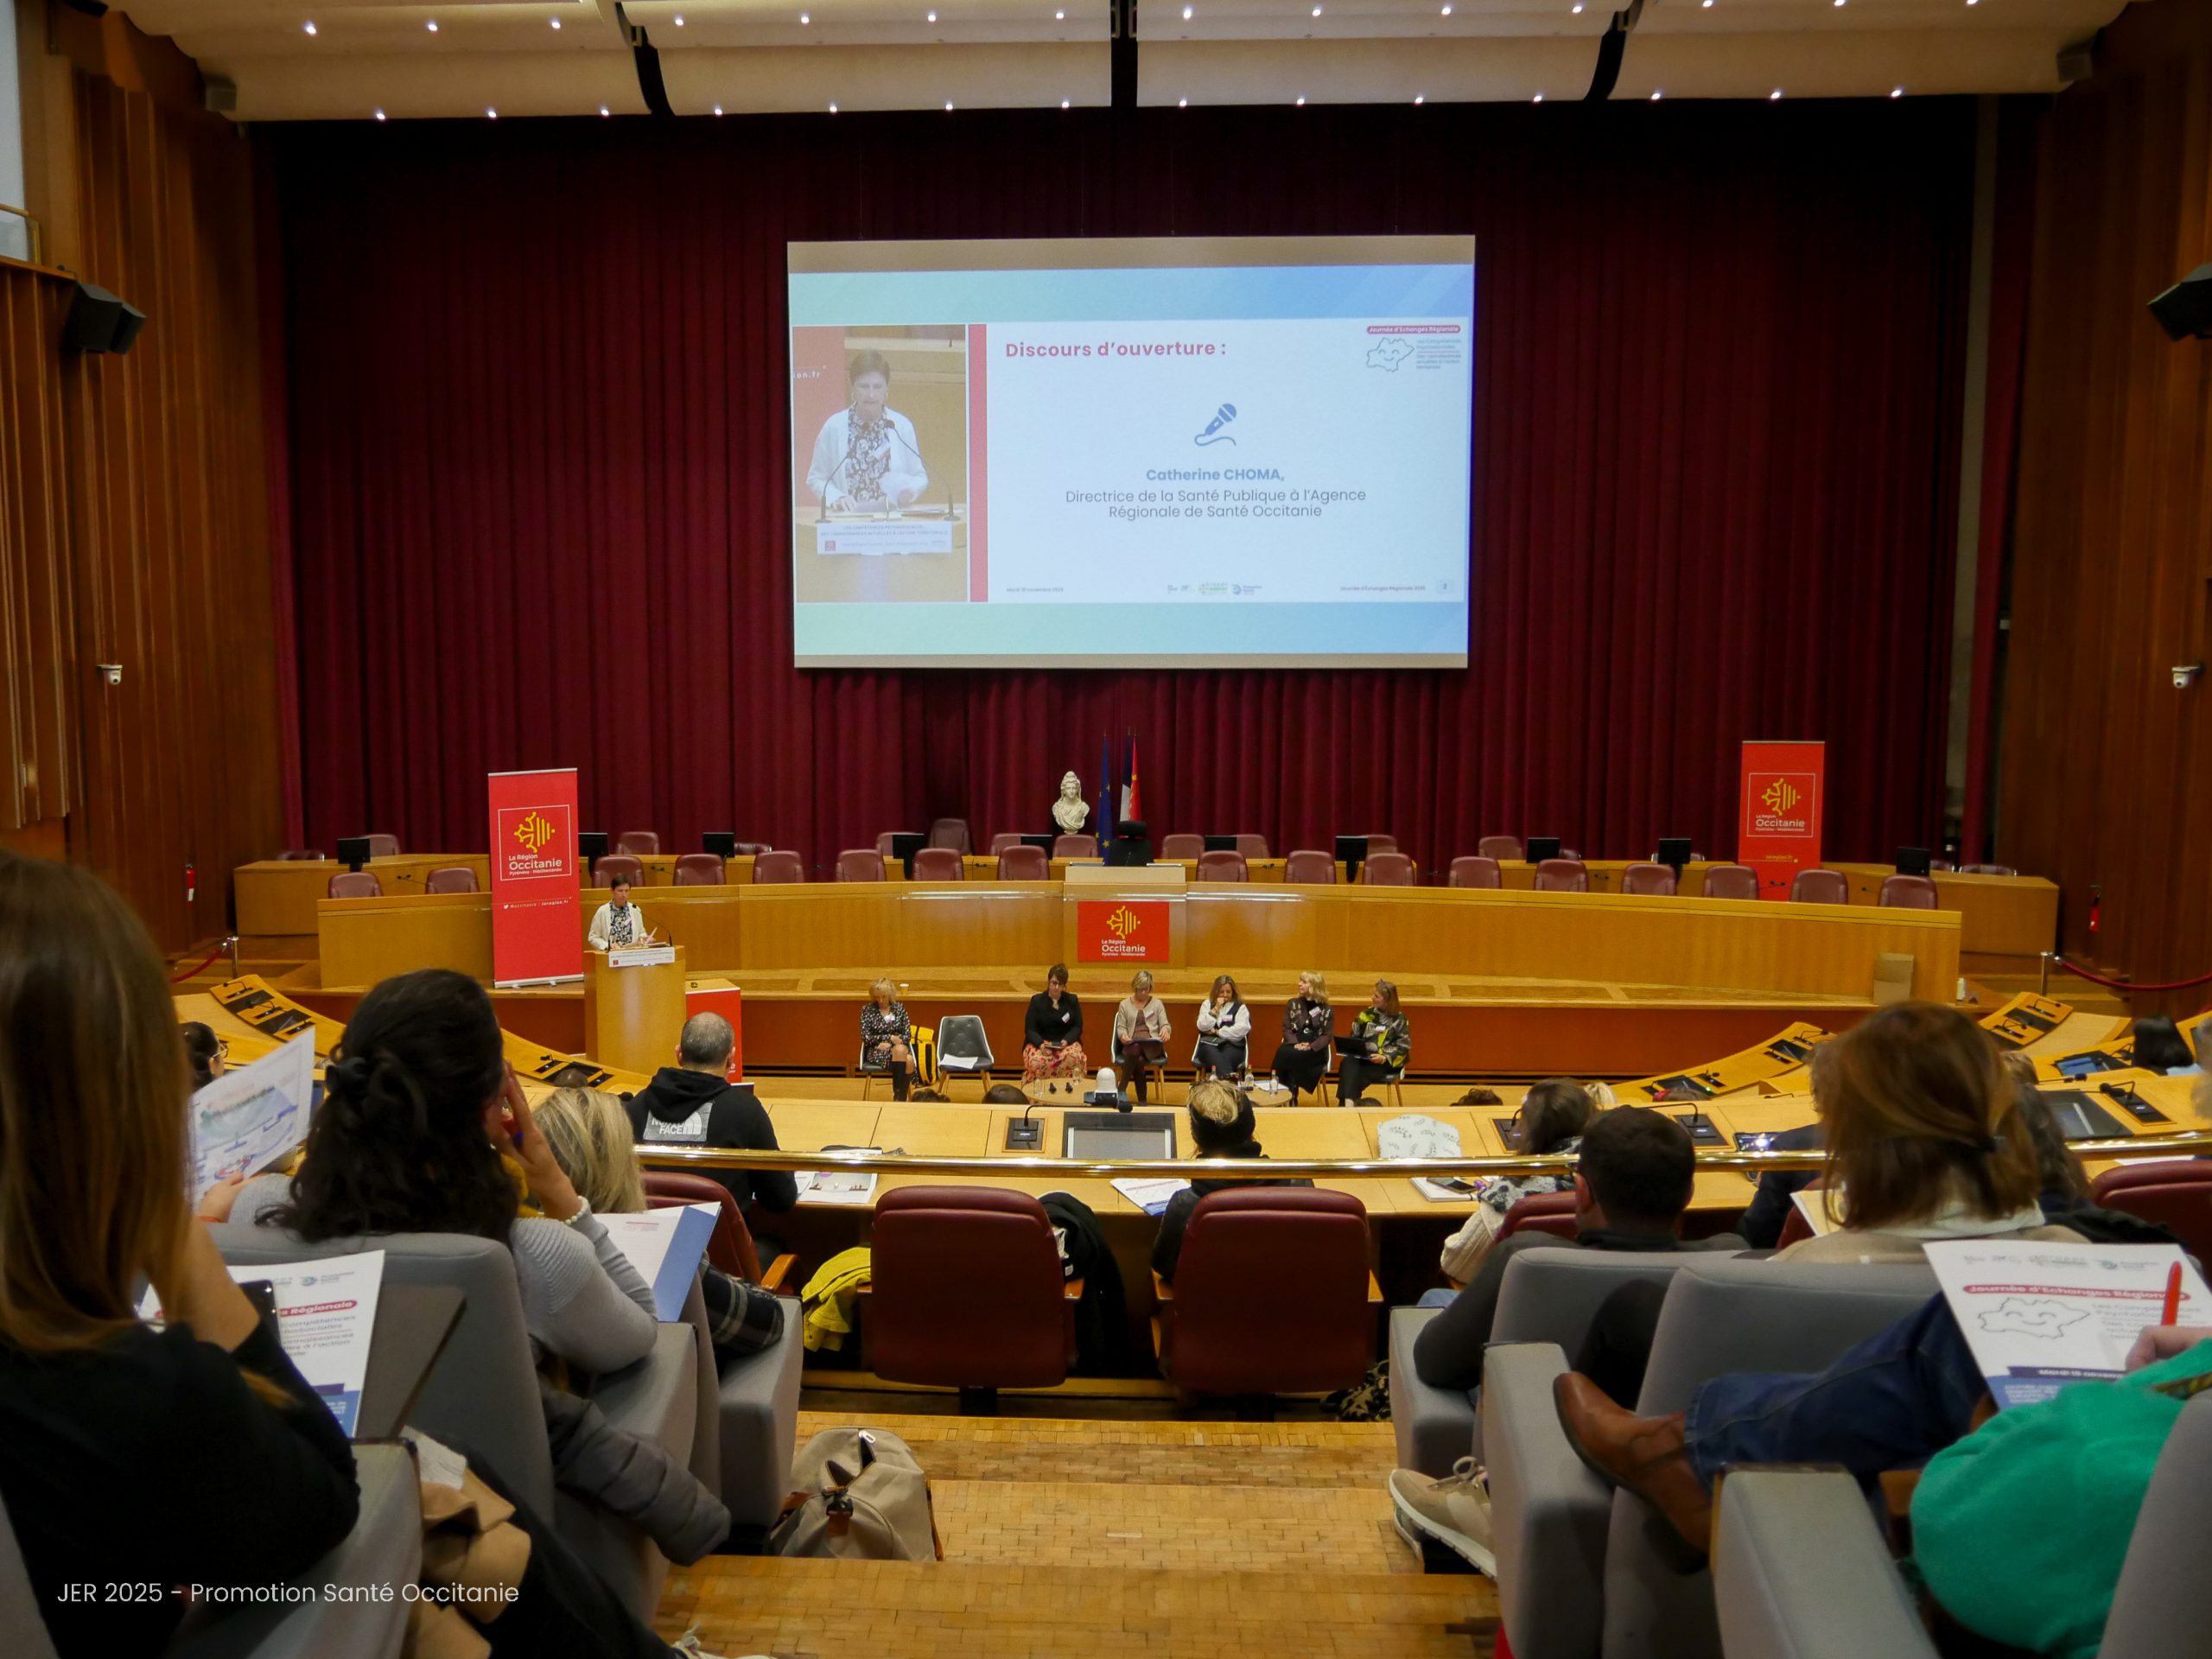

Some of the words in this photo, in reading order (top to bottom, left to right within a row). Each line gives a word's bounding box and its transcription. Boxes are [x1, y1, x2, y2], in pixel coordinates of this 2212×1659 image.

[1006, 342, 1091, 357] Discours
[1146, 468, 1220, 481] Catherine
[1224, 468, 1285, 482] CHOMA,
[1065, 490, 1135, 503] Directrice
[1138, 490, 1157, 502] de
[1160, 490, 1173, 502] la
[1178, 489, 1219, 502] Santé
[1224, 489, 1286, 505] Publique
[1290, 489, 1300, 501] à
[1109, 505, 1180, 521] Régionale
[1185, 505, 1203, 518] de
[1207, 505, 1249, 518] Santé
[1253, 505, 1322, 517] Occitanie
[1756, 818, 1804, 828] Occitanie
[509, 857, 563, 871] Occitanie
[1101, 944, 1146, 953] Occitanie
[658, 1124, 683, 1135] FACE
[289, 1300, 353, 1314] Régionale
